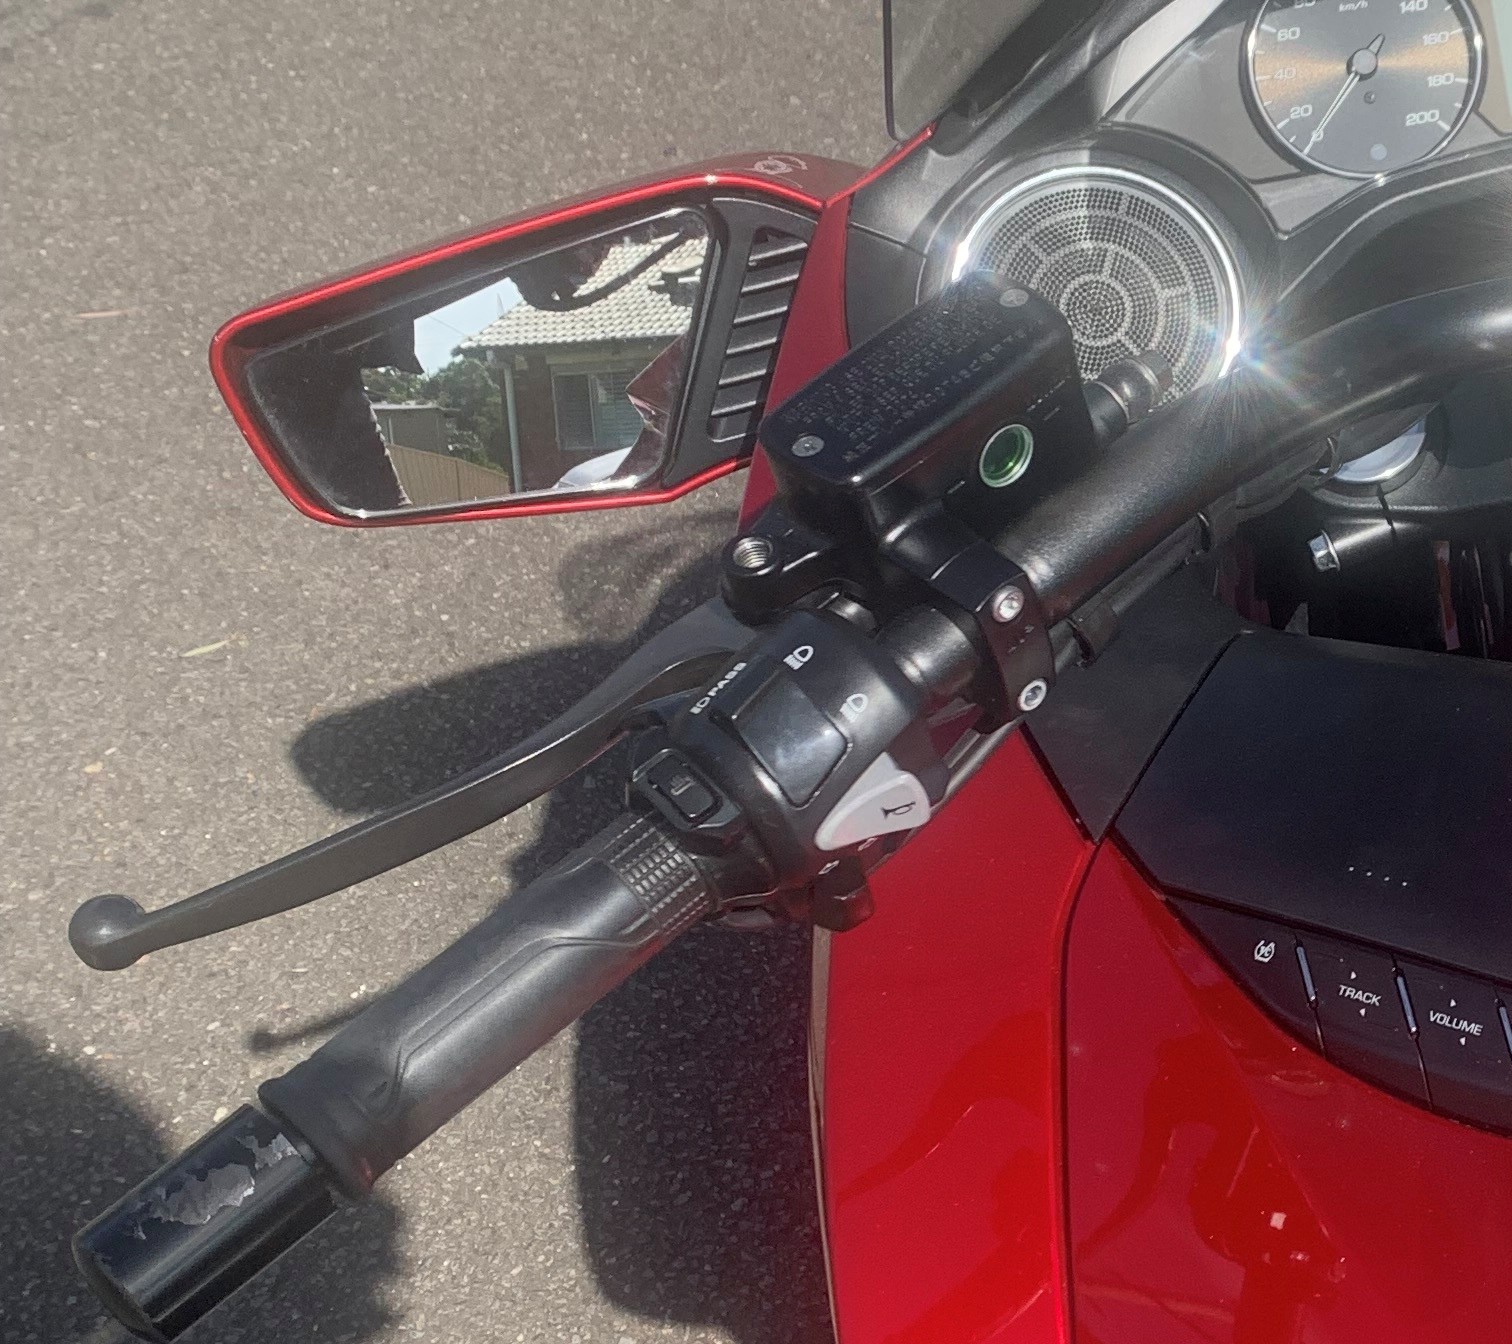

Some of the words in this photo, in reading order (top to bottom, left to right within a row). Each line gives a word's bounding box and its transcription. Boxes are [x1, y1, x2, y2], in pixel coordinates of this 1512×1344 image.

[1338, 0, 1369, 13] km/h
[1276, 27, 1301, 41] 60
[1422, 31, 1450, 47] 160
[1273, 67, 1297, 80] 40
[1426, 73, 1455, 88] 180
[1289, 104, 1313, 119] 20
[1405, 109, 1440, 127] 200
[1338, 984, 1382, 1007] TRACK
[1428, 1009, 1484, 1038] VOLUME
